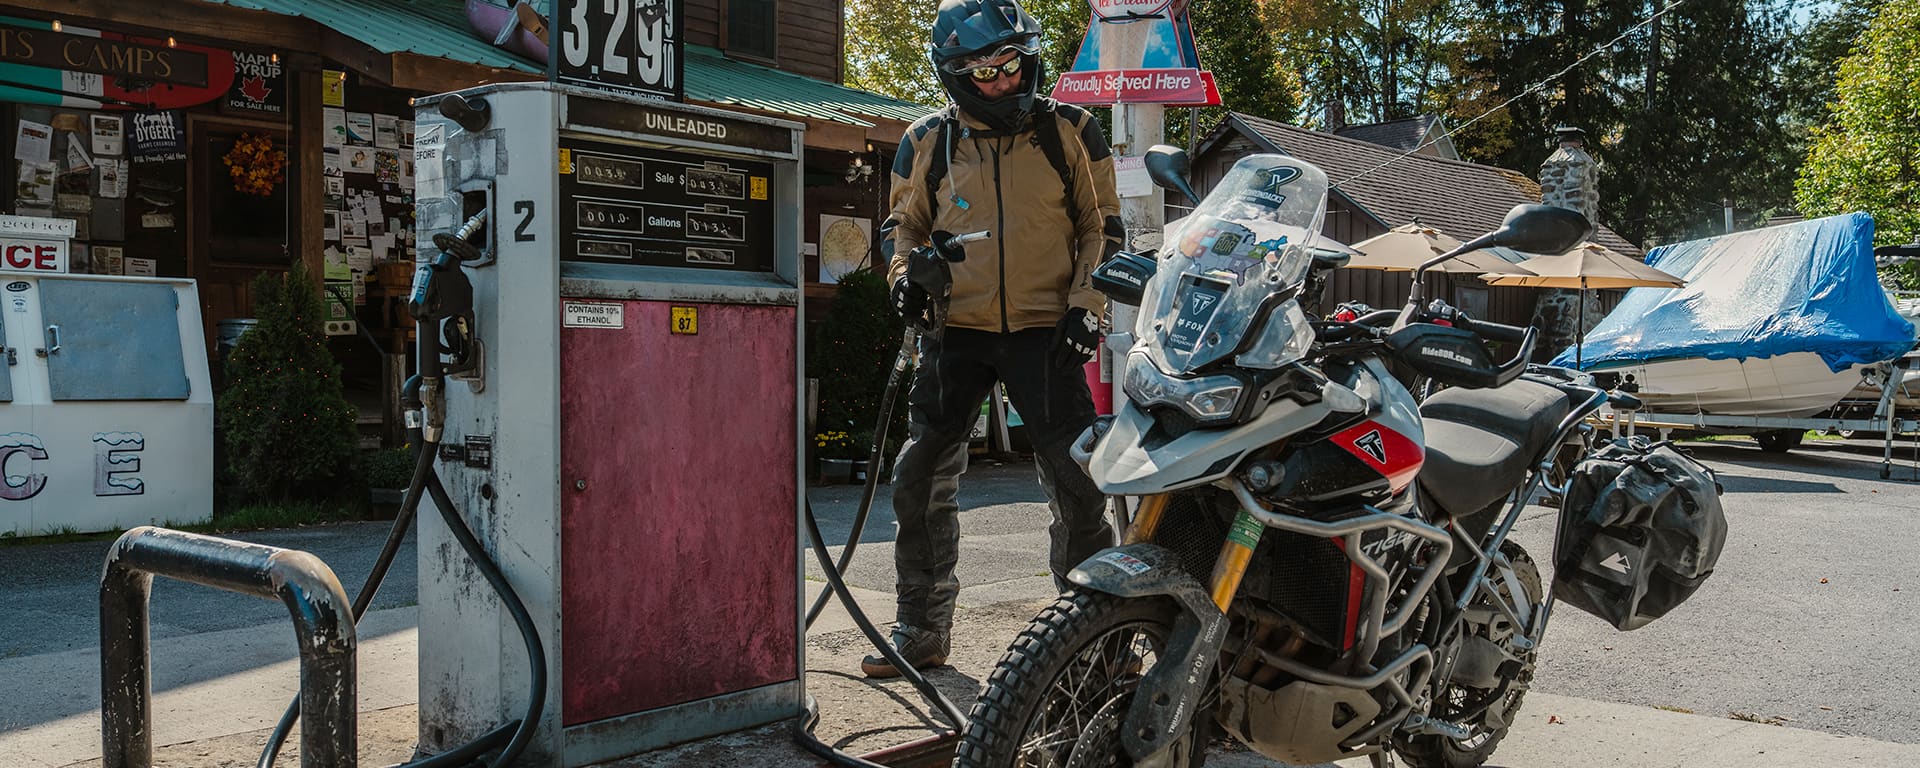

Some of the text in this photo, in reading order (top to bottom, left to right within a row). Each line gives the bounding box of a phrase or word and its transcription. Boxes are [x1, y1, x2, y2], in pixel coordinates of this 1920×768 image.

[63, 39, 172, 78] CAMPS
[232, 50, 281, 69] MAPLE
[232, 62, 282, 79] SYRUP
[1061, 76, 1102, 96] Proudly
[1103, 73, 1152, 91] Served
[1154, 73, 1191, 90] Here
[230, 99, 245, 108] FOR
[246, 102, 263, 110] SALE
[135, 124, 176, 142] DYGERT
[645, 112, 727, 139] UNLEADED
[416, 149, 436, 161] EFORE
[655, 171, 675, 184] Sale
[514, 200, 536, 242] 2
[648, 215, 682, 228] Gallons
[0, 245, 58, 271] CE
[567, 305, 620, 316] CONTAINS 10%
[577, 315, 612, 325] ETHANOL
[678, 317, 692, 331] 87
[1184, 320, 1204, 332] FOX
[1421, 346, 1473, 367] RideBDR.com
[1362, 530, 1412, 557] TIGE
[1192, 652, 1205, 675] FOX
